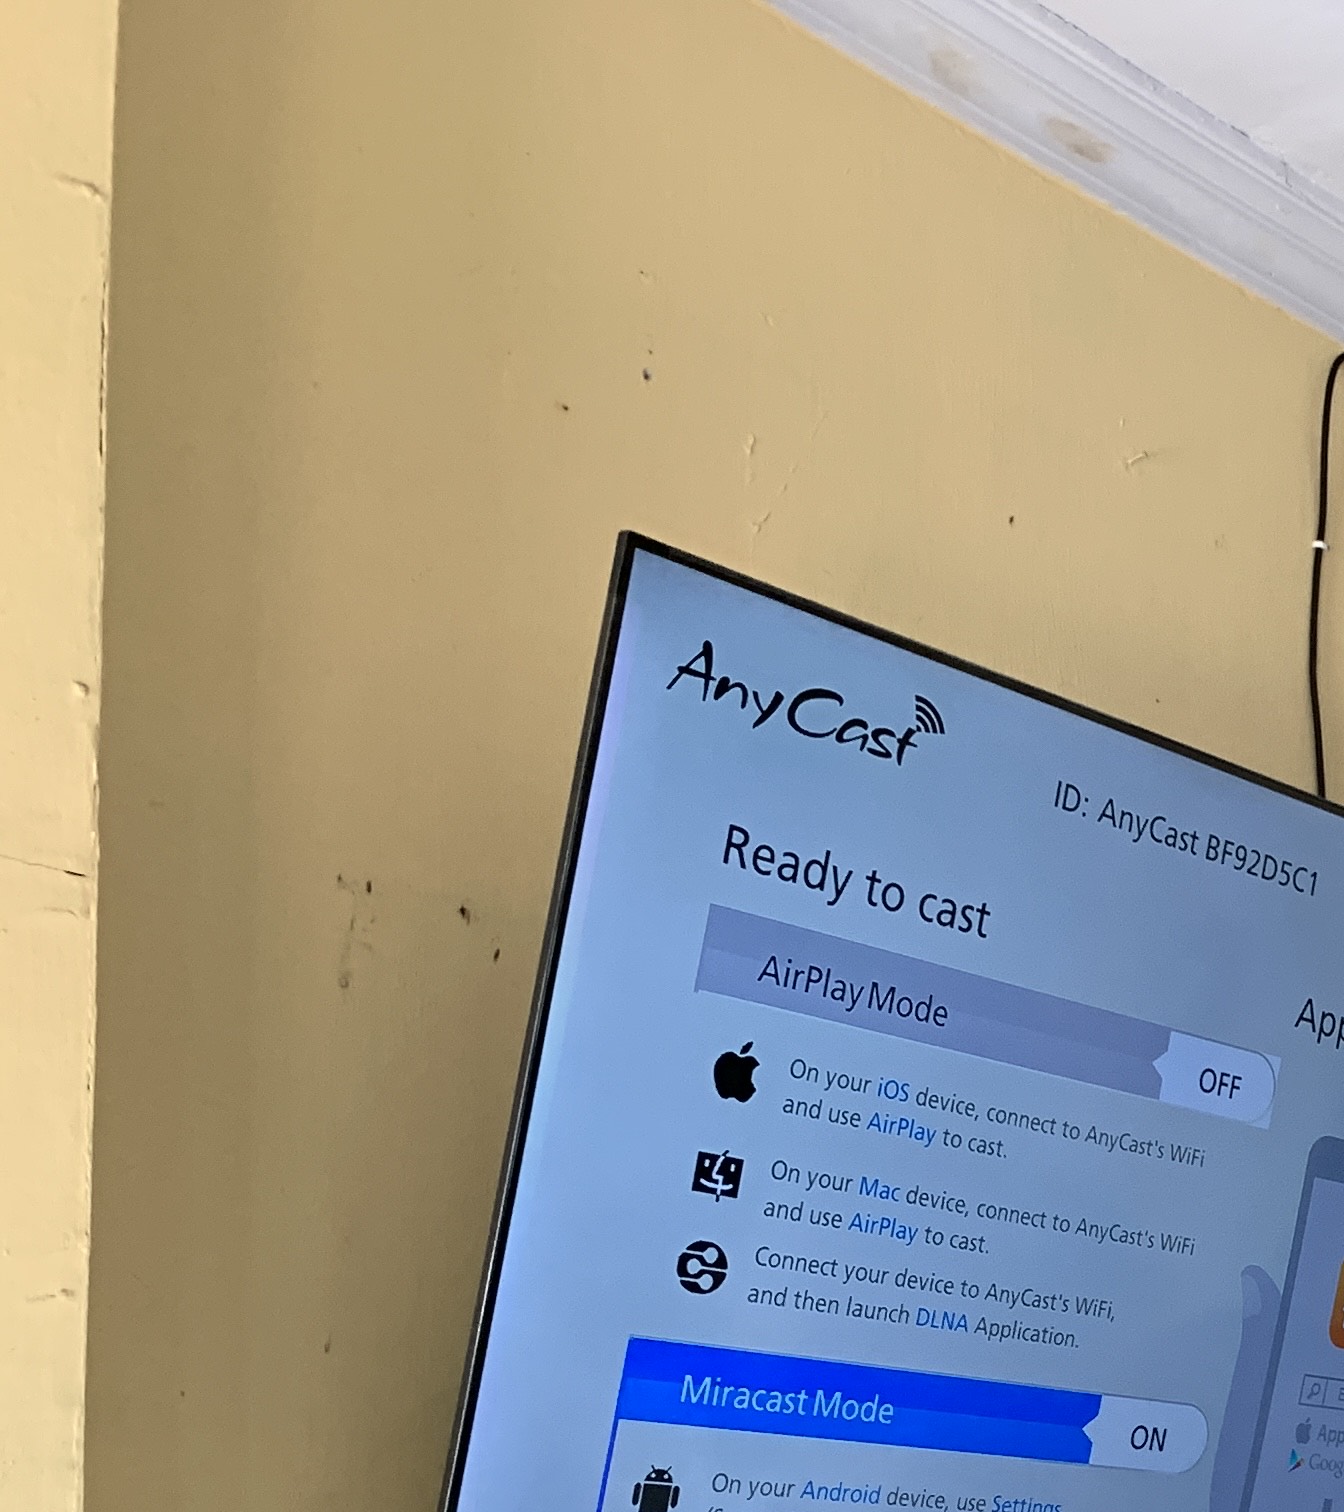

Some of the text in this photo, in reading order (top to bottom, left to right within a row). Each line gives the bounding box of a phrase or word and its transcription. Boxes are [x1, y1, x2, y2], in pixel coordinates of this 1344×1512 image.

[666, 640, 918, 766] AnyCast
[1054, 780, 1318, 896] ID: AnyCast BF92D5C1
[722, 824, 992, 939] Ready to cast
[790, 1058, 1206, 1169] On your iOS device, connect to AnyCast's WiFi
[1199, 1067, 1243, 1101] OFF
[782, 1097, 1008, 1159] and use AirPlay to cast.
[763, 1201, 990, 1254] and use AirPlay to cast.
[770, 1159, 1197, 1256] On your Mac device, connect to AnyCast's WiFi
[755, 1246, 1116, 1322] Connect your device to AnyCast's WiFi,
[747, 1286, 1080, 1350] and then launch DLNA Application.
[679, 1374, 896, 1427] Miracast Mode
[1129, 1424, 1168, 1453] ON
[711, 1472, 742, 1497] On
[747, 1479, 797, 1504] your
[800, 1479, 882, 1506] Android
